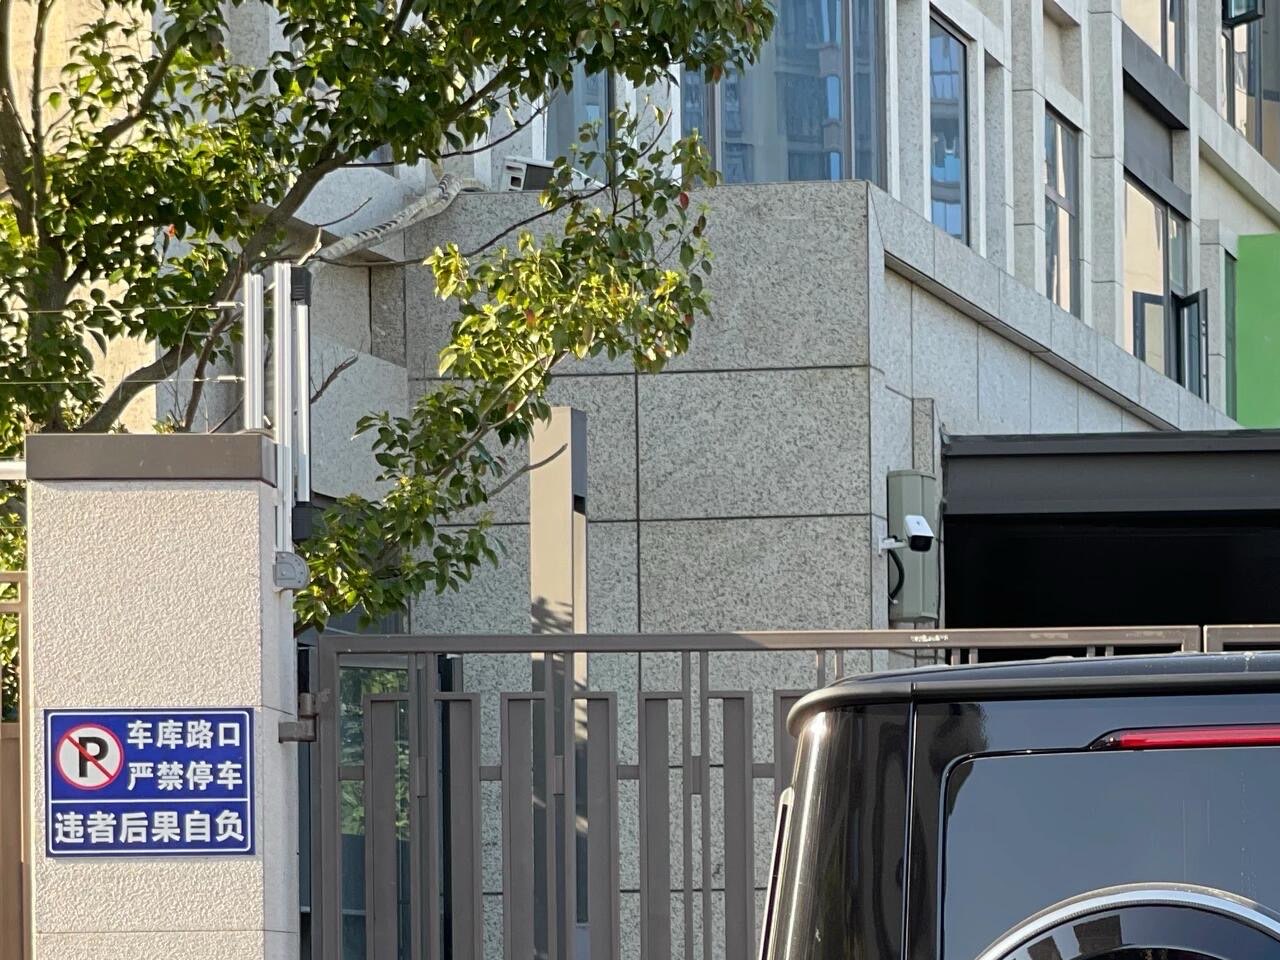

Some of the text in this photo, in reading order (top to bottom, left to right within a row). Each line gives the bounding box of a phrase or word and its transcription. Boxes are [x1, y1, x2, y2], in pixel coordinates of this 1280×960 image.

[127, 719, 240, 749] 车库路口
[127, 760, 243, 791] 严禁停车
[55, 809, 244, 844] 违者后果自负
